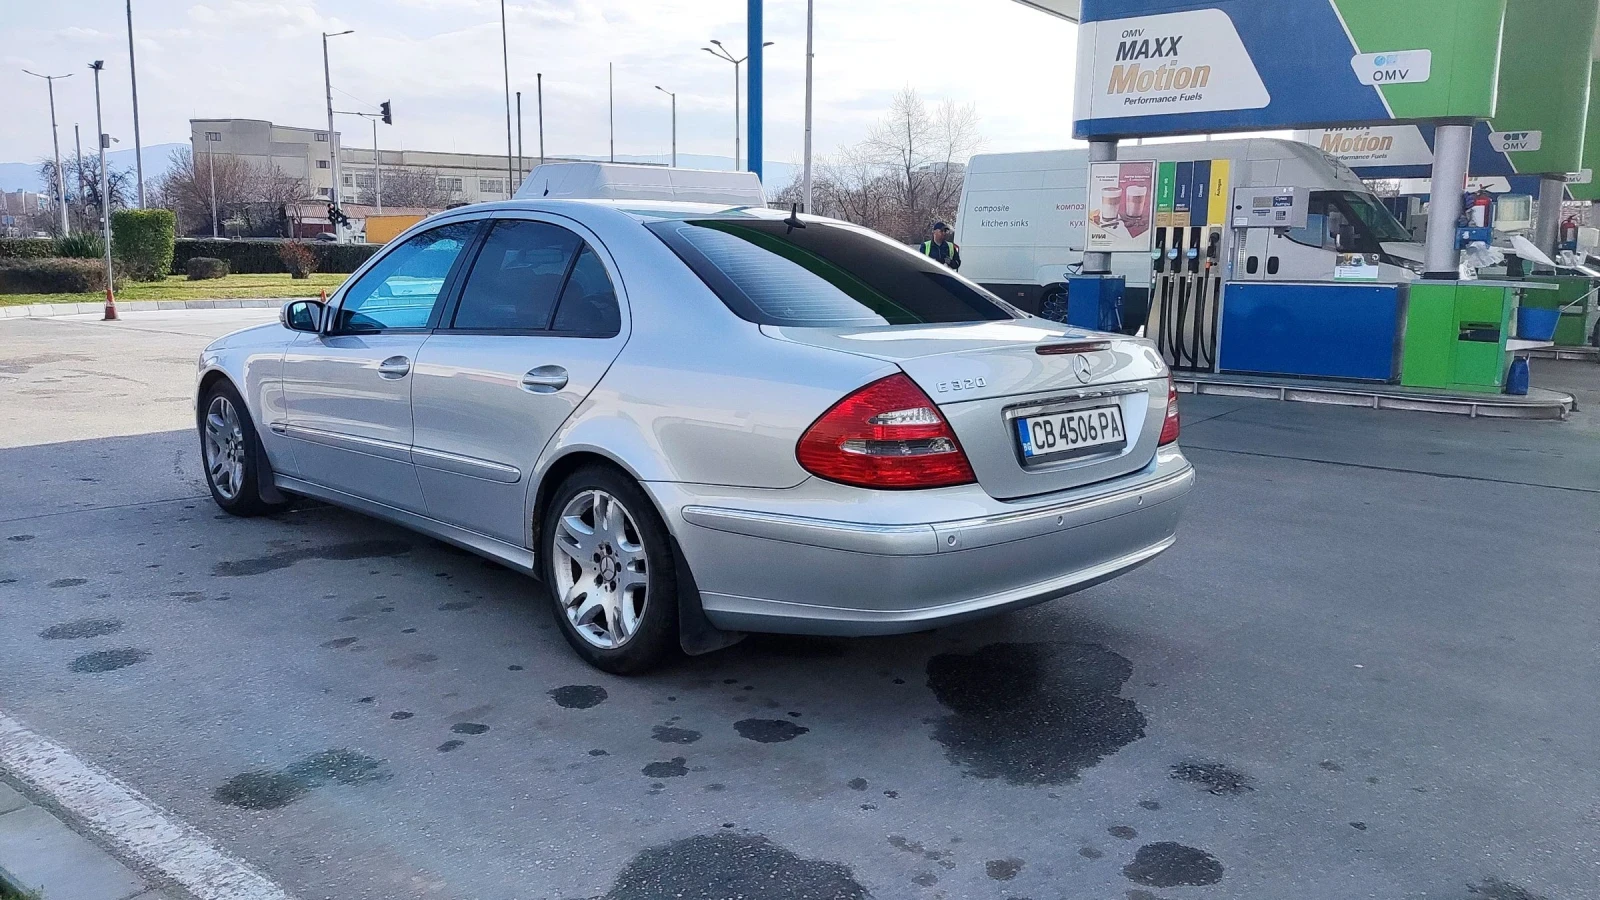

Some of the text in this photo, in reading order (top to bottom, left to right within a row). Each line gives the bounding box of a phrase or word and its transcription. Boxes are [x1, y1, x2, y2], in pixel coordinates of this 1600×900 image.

[1121, 28, 1145, 39] OMV
[1115, 35, 1183, 62] MAXX
[1106, 60, 1211, 95] Motion
[1372, 68, 1410, 82] OMV
[1123, 92, 1203, 106] Performance Fuels
[1320, 131, 1394, 153] Motion
[1502, 142, 1528, 150] OMV
[974, 204, 1010, 213] composite
[981, 219, 1029, 228] kitchen sinks
[936, 376, 987, 393] E 320
[1059, 413, 1098, 446] 4506
